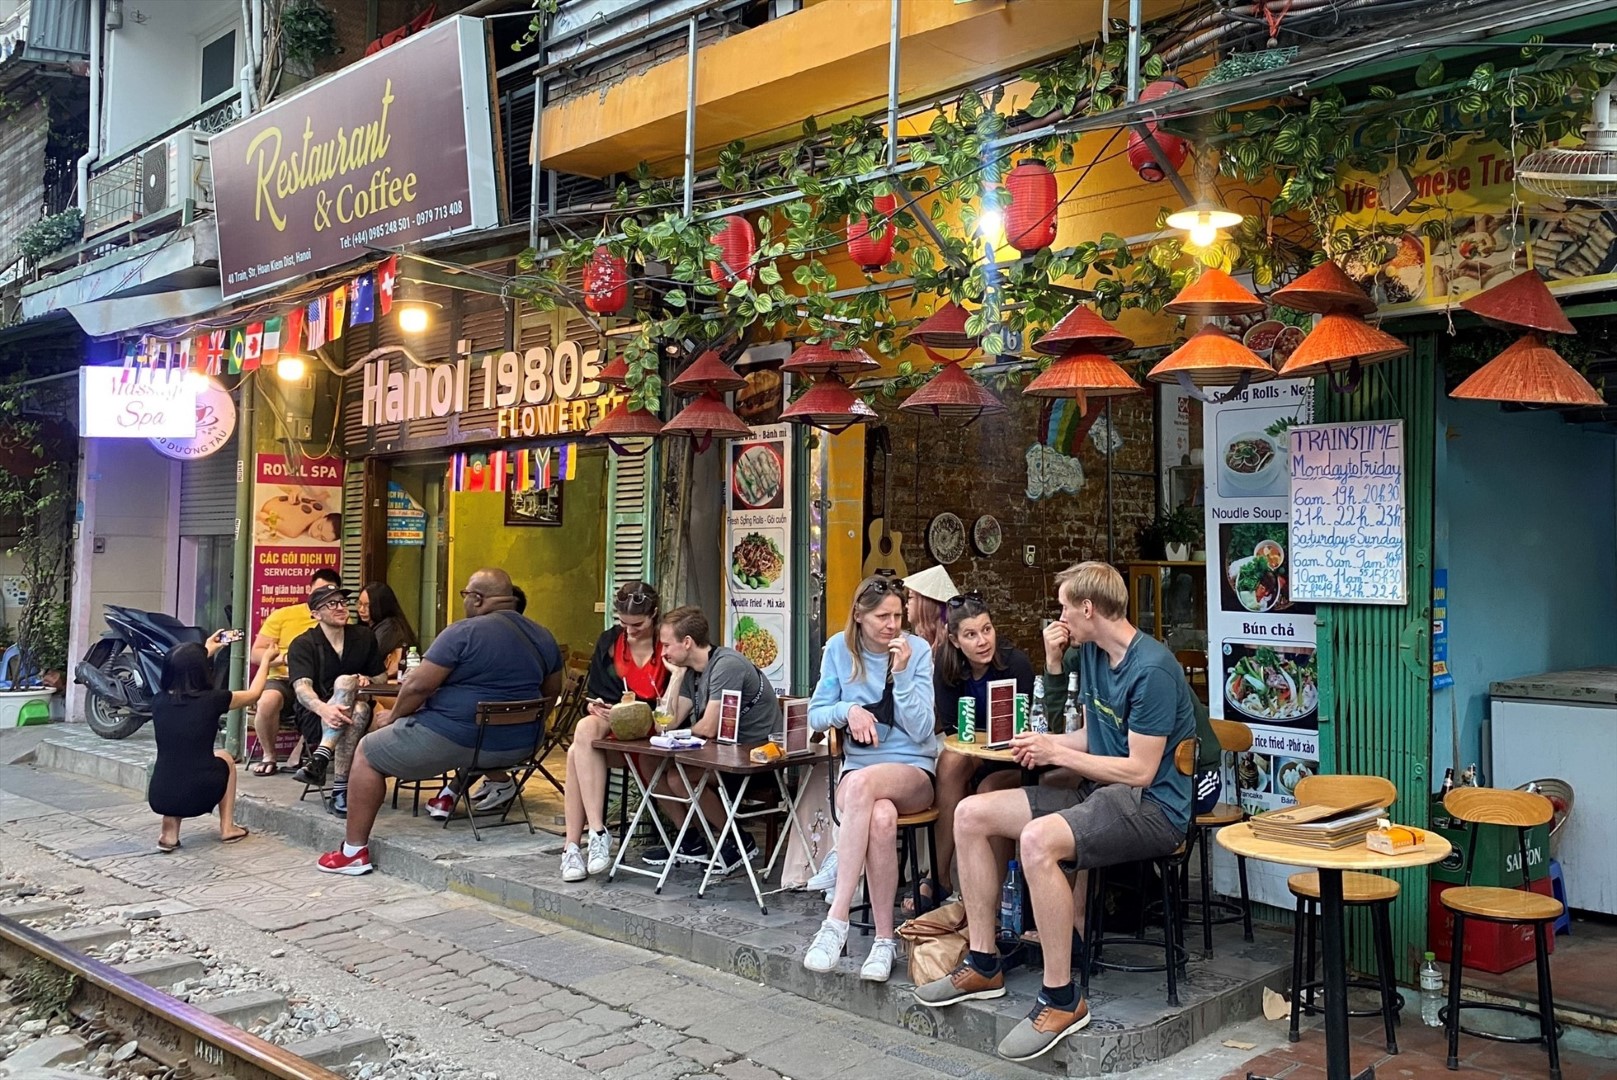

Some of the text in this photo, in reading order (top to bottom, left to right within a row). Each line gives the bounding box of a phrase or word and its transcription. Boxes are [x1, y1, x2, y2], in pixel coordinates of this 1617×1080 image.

[246, 78, 395, 231] Restaurant
[313, 166, 417, 232] & Coffee
[340, 234, 351, 249] Tel:
[352, 230, 368, 248] (+84)
[368, 224, 384, 240] 0985
[384, 220, 398, 236] 248
[398, 217, 411, 231] 501
[416, 209, 434, 226] 0979
[434, 205, 447, 220] 713
[449, 200, 463, 216] 408
[257, 264, 270, 275] Hoan
[270, 260, 283, 271] Kiem
[295, 247, 312, 263] Hanoi
[362, 339, 607, 426] Hanoi 1980s
[1252, 386, 1279, 399] Rolls
[117, 400, 166, 430] Spa
[498, 399, 592, 437] FLOWER
[311, 465, 337, 478] SPA
[1291, 452, 1347, 483] Monday
[1360, 450, 1402, 484] Friday
[1294, 487, 1326, 505] 6am
[1332, 485, 1356, 505] 19h
[753, 515, 763, 524] Rolls
[1212, 507, 1249, 519] Noudle
[1253, 507, 1281, 520] Soup
[1294, 504, 1400, 527] 21h 22h 23h
[1292, 526, 1348, 555] Saturday
[1357, 526, 1402, 555] Sunday
[259, 551, 336, 567] CÁC GÓI DỊCH VỤ
[1294, 551, 1320, 567] 6am
[1325, 549, 1352, 568] 8am
[264, 568, 303, 576] SERVICER
[1294, 568, 1328, 583] 10am
[261, 596, 275, 604] Body
[750, 598, 762, 607] Fried
[1242, 621, 1295, 637] Bún chả
[962, 699, 976, 742] Sprite
[1255, 734, 1267, 748] rice
[1269, 735, 1285, 750] fried
[1302, 740, 1315, 754] xào
